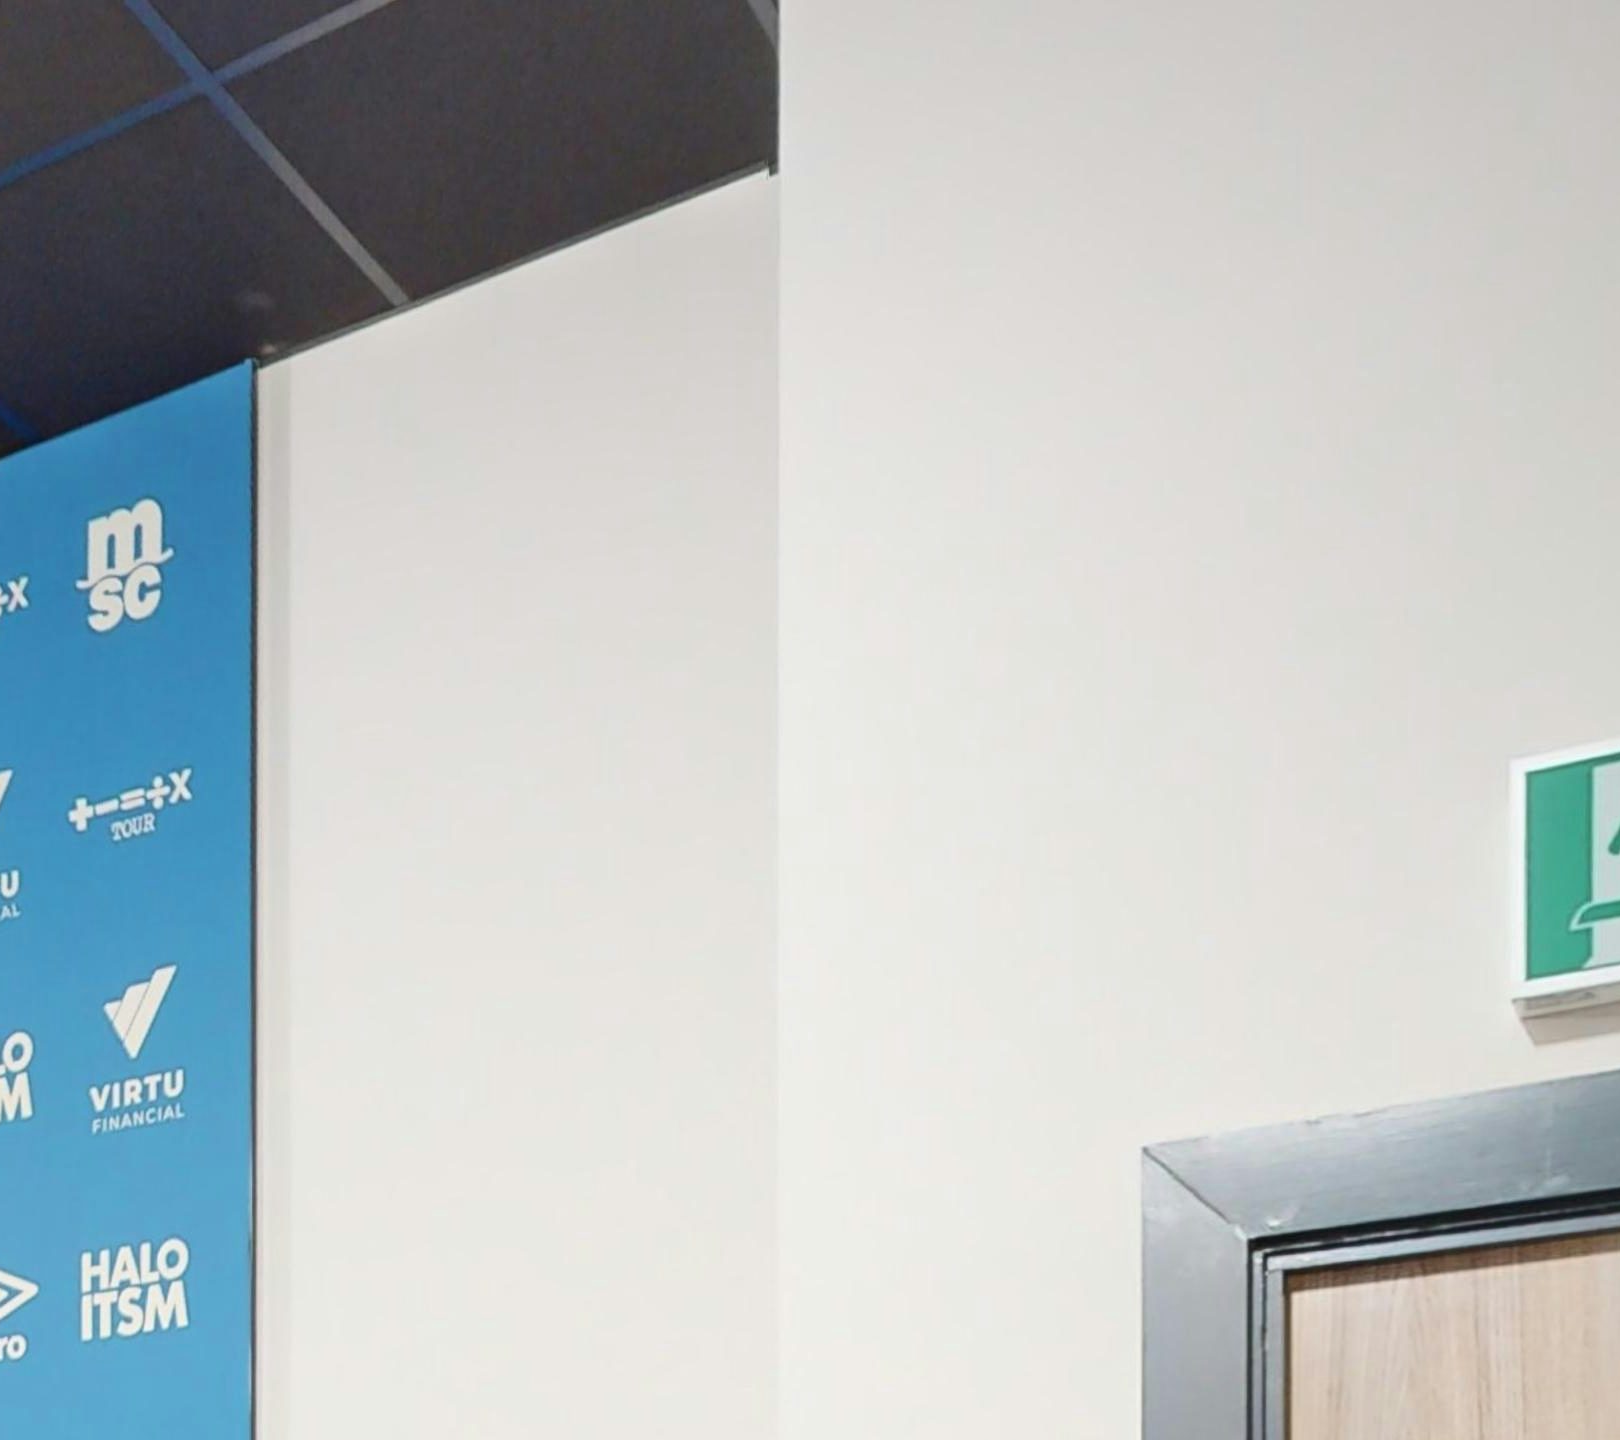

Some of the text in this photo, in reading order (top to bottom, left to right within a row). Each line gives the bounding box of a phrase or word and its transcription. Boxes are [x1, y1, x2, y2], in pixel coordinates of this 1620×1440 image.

[111, 813, 155, 840] TOUR
[90, 1070, 183, 1112] VIRTU
[92, 1104, 184, 1133] FINANCIAL
[81, 1238, 188, 1298] HALO
[81, 1280, 188, 1341] ITSM
